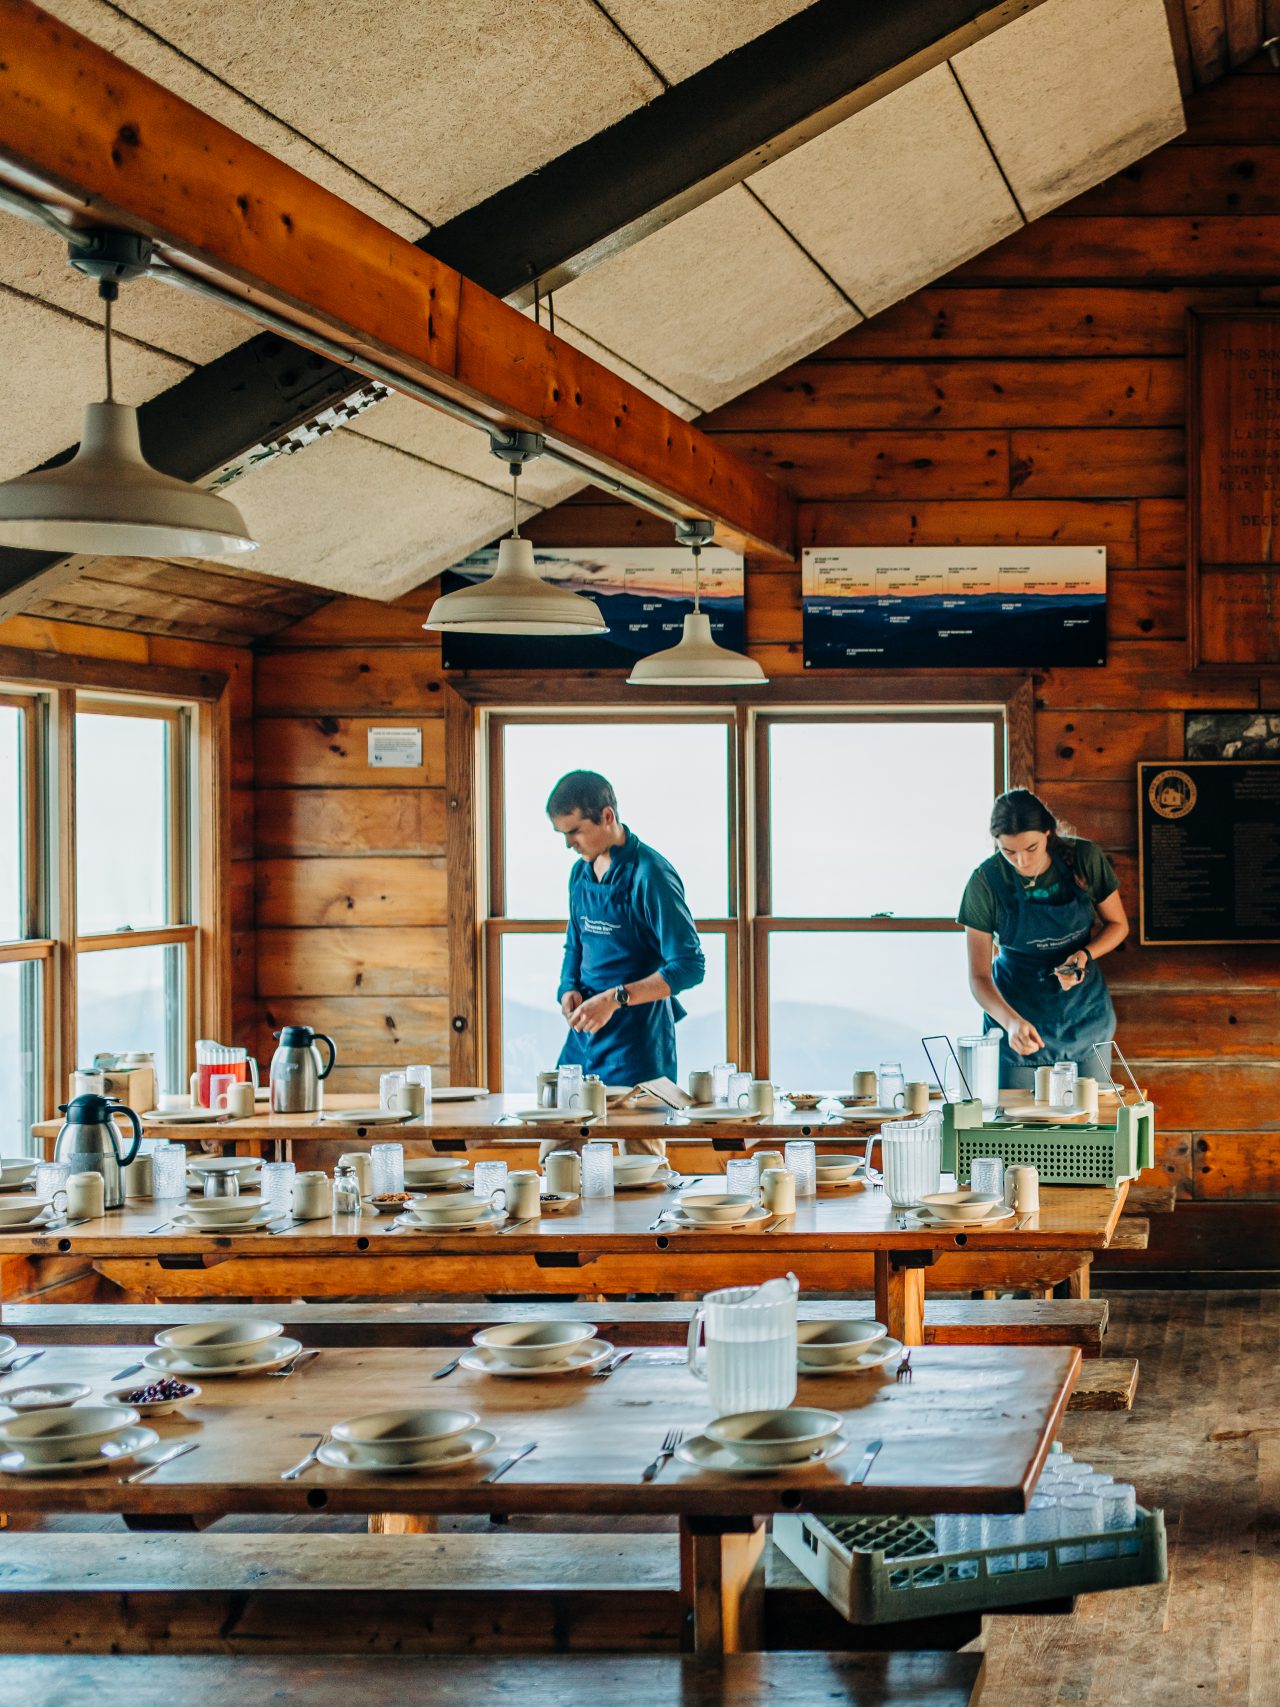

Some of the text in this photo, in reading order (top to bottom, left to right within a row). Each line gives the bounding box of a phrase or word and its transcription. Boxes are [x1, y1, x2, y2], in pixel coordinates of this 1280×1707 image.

[1222, 349, 1250, 361] THIS
[1240, 368, 1256, 380] TO
[1235, 428, 1280, 440] LAKES
